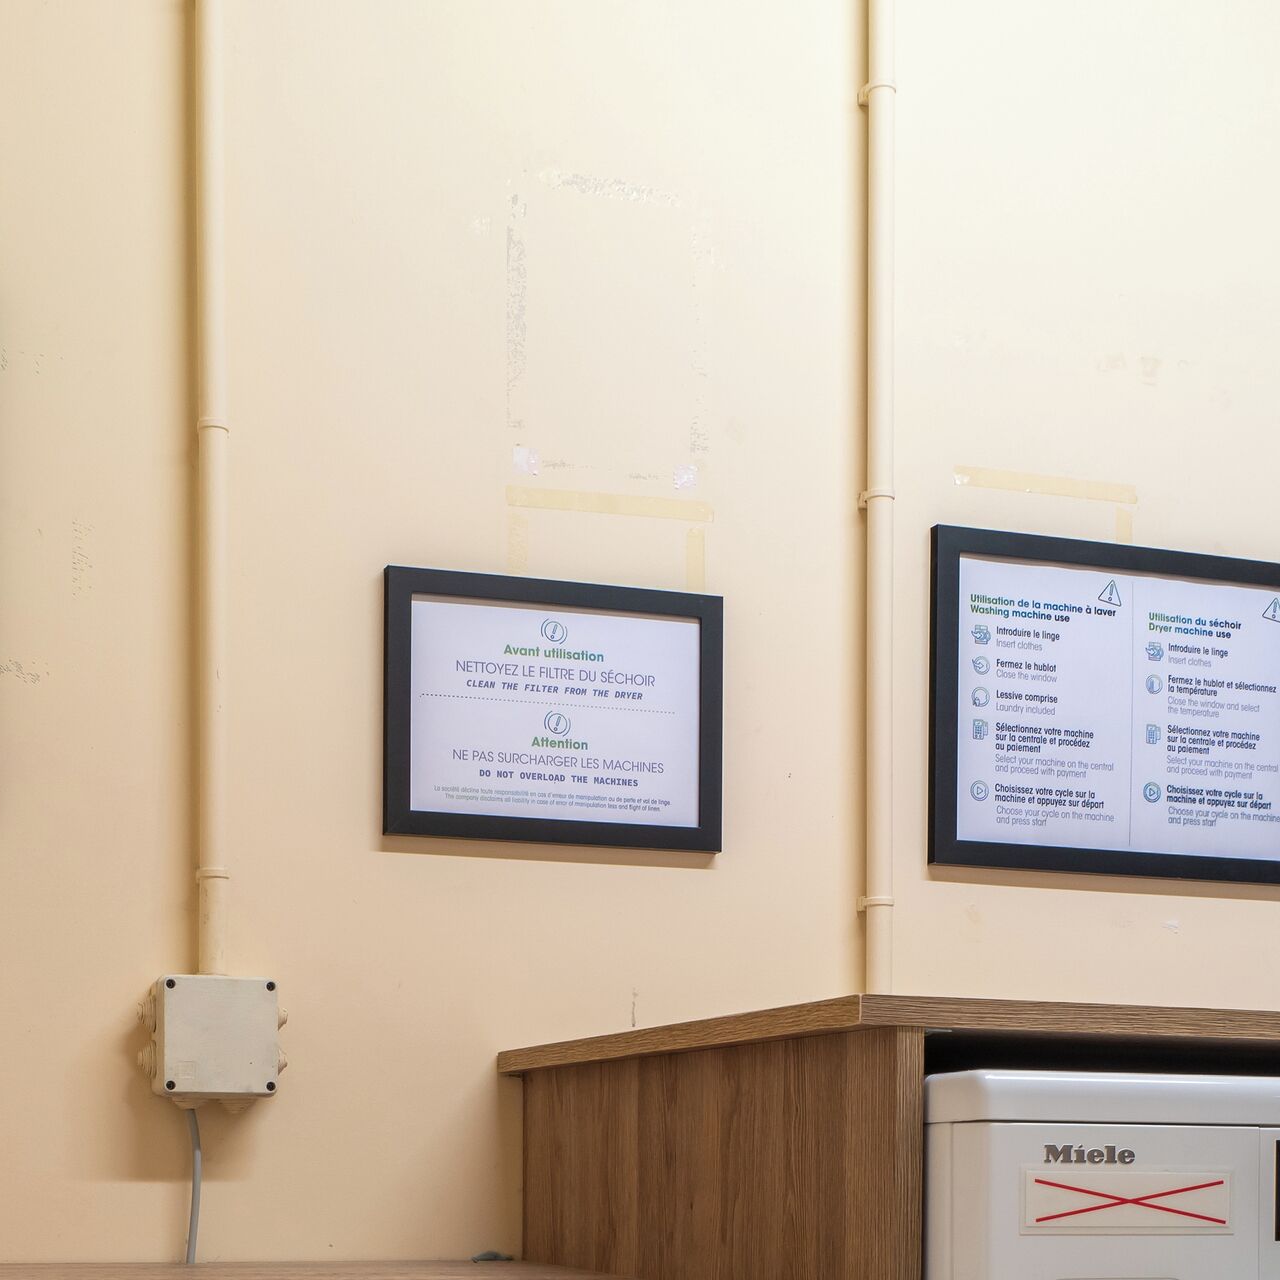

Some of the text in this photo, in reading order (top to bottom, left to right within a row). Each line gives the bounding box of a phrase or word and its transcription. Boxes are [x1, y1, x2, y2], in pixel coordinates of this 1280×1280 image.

[971, 593, 1116, 616] Utilisation de la machine à laver
[971, 603, 1070, 622] Washing machine use
[1149, 612, 1241, 629] Utilisation du séchoir
[997, 625, 1060, 642] Introduire le linge
[1149, 622, 1231, 639] Dryer machine use
[504, 644, 604, 662] Avant utilisation
[456, 659, 655, 687] NETTOYEZ LE FILTRE DU SÉCHOIR
[467, 679, 642, 700] CLEAN THE FILTER FROM THE DRYER
[997, 689, 1057, 704] Lessive comprise
[532, 736, 588, 750] Attention
[453, 748, 664, 773] NE PAS SURCHARGER LES MACHINES
[480, 768, 638, 786] DO NOT OVERLOAD THE MACHINES
[1043, 1144, 1136, 1165] Miele
